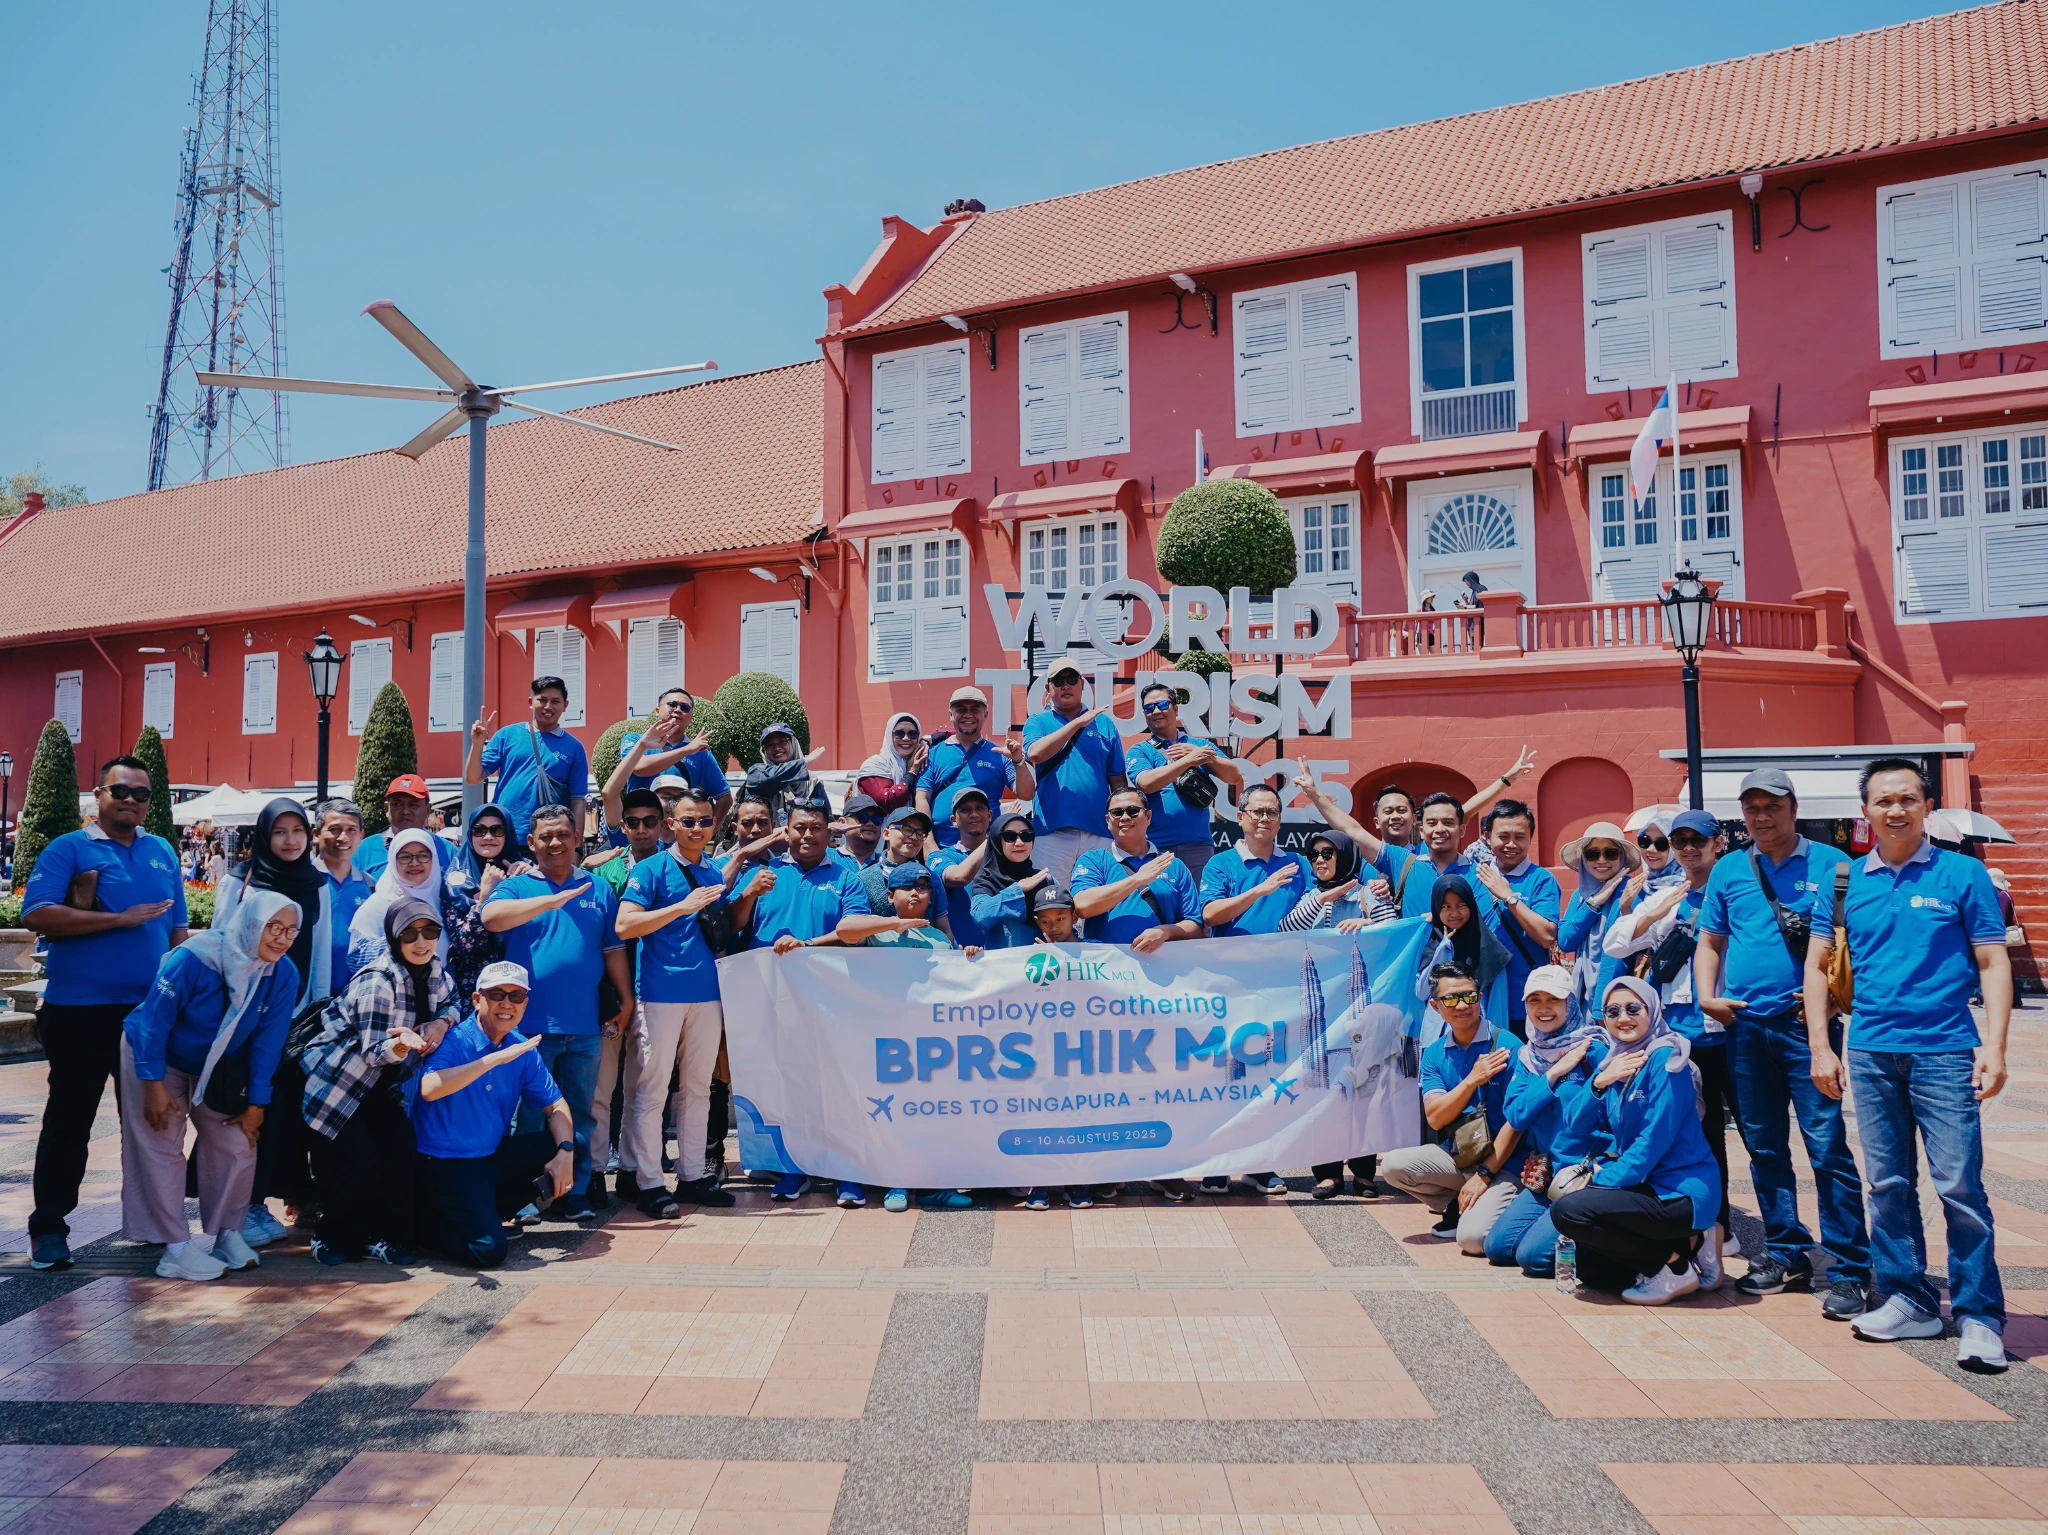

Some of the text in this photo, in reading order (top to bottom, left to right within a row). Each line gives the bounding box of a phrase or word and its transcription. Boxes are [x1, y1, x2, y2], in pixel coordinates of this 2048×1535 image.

[983, 574, 1340, 659] WORLD
[1210, 758, 1354, 823] 025
[489, 963, 523, 975] HORNETS
[1065, 961, 1136, 981] HIK MCI
[932, 993, 1228, 1028] Employee Gathering
[875, 1020, 1287, 1083] BPRS HIK MCI
[902, 1100, 963, 1117] GOES
[969, 1099, 999, 1115] TO
[1006, 1091, 1131, 1114] SINGAPURA
[1154, 1084, 1264, 1105] MALAYSIA
[1013, 1136, 1022, 1146] 8
[1037, 1135, 1052, 1146] 10
[1057, 1131, 1120, 1145] AGUSTUS
[1125, 1129, 1157, 1141] 2025
